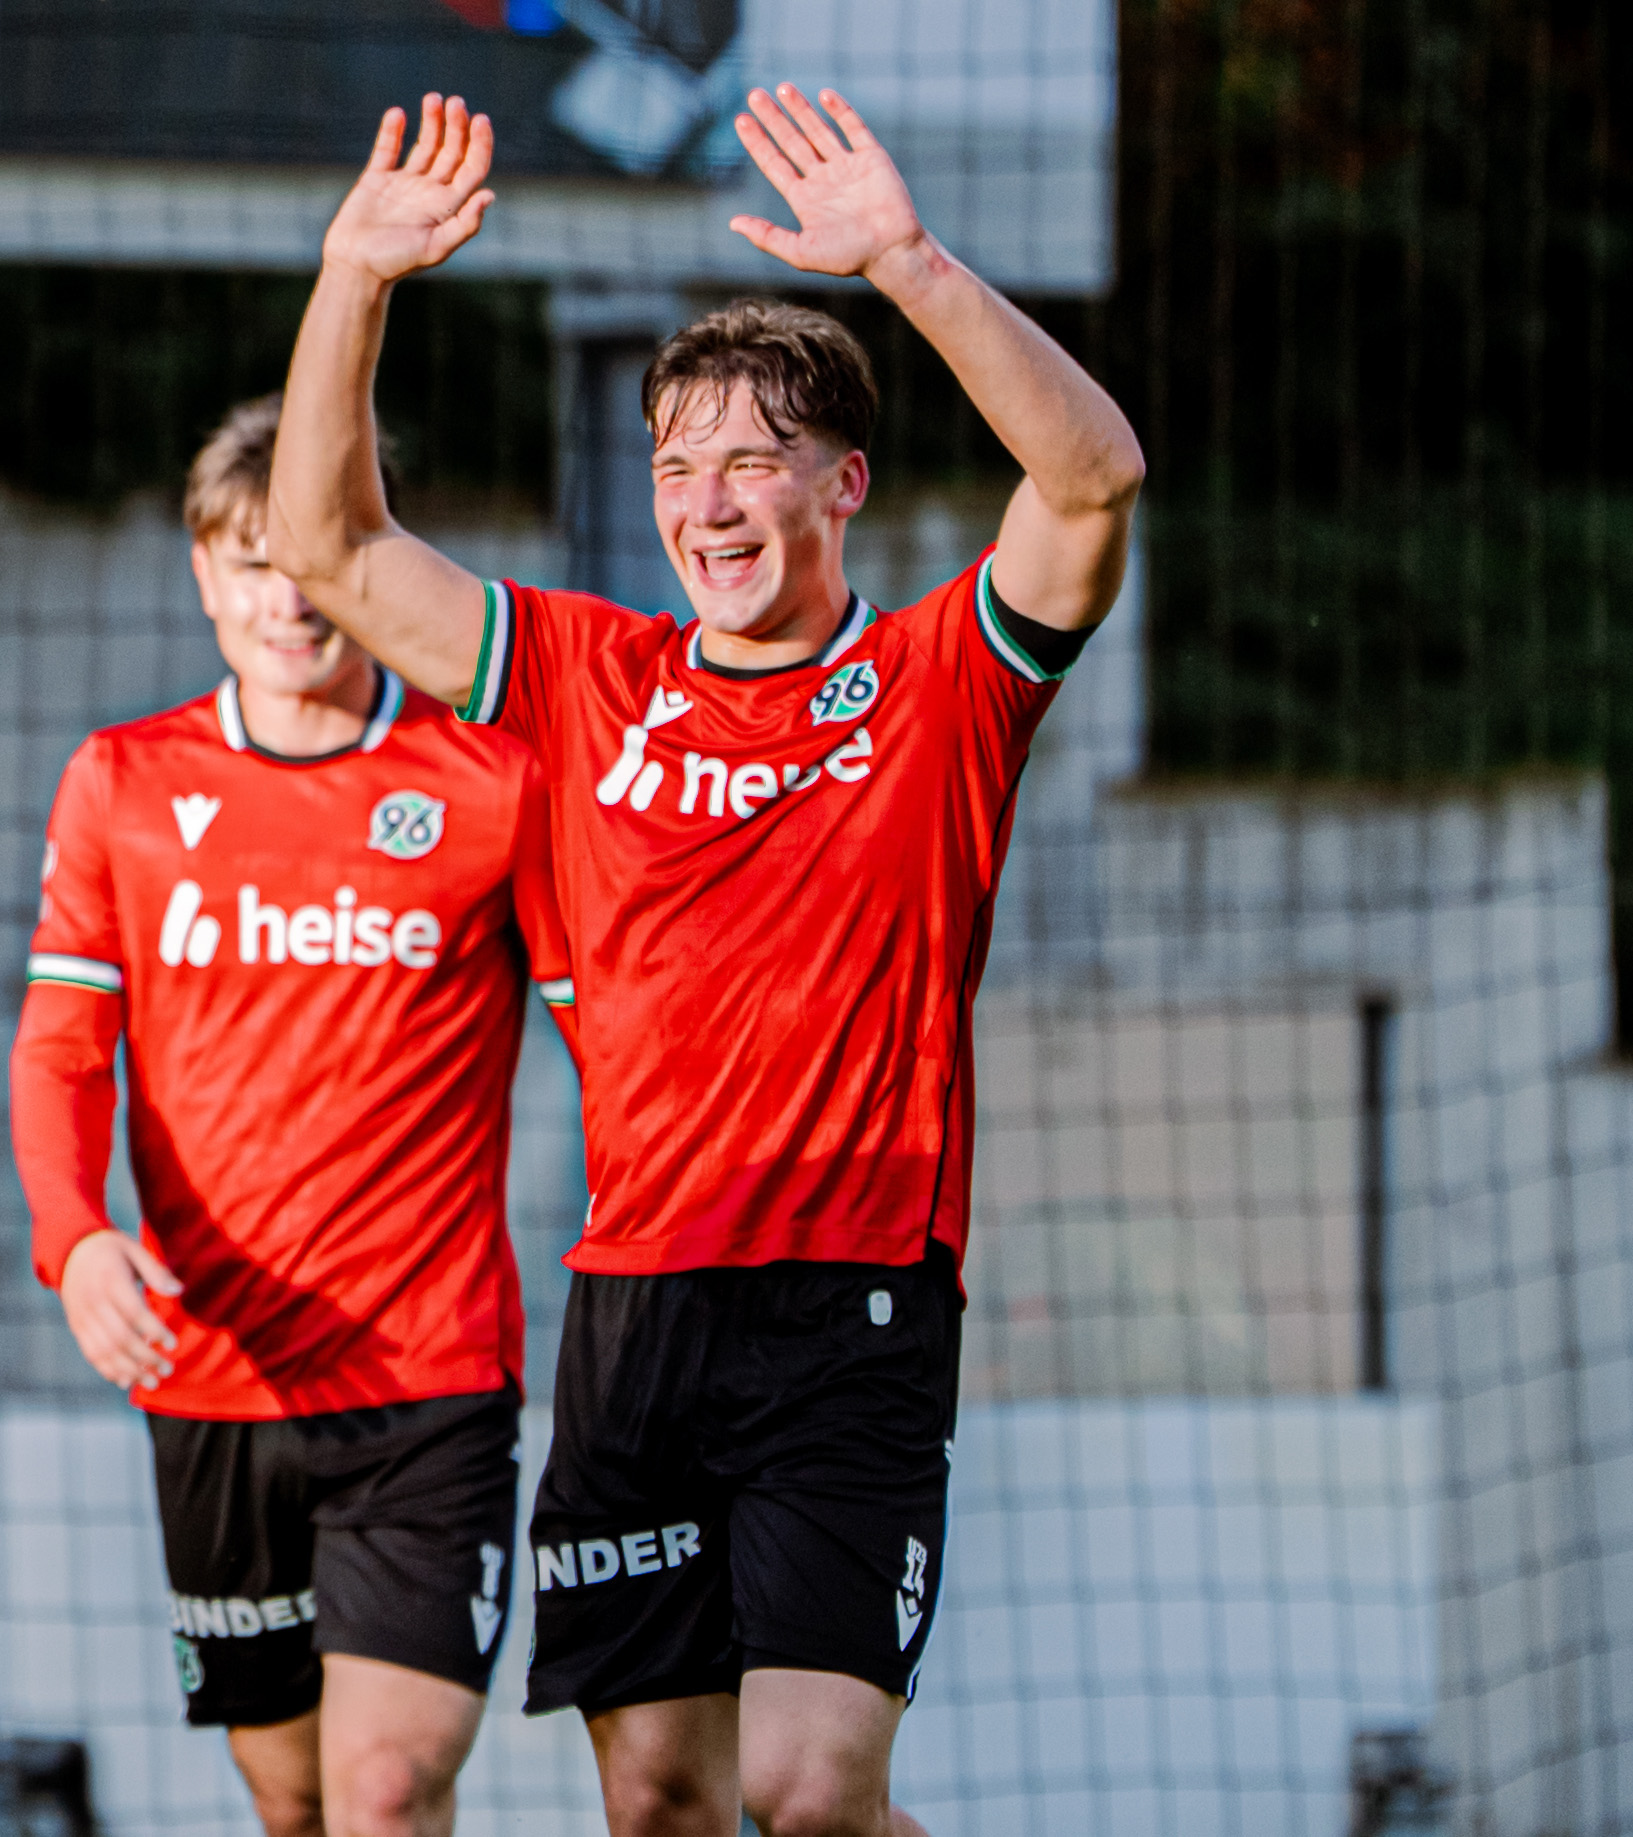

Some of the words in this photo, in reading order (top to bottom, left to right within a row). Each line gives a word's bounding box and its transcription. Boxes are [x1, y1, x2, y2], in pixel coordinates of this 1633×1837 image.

[815, 665, 874, 718] 96
[237, 883, 442, 970] heise
[536, 1521, 702, 1592] NDER
